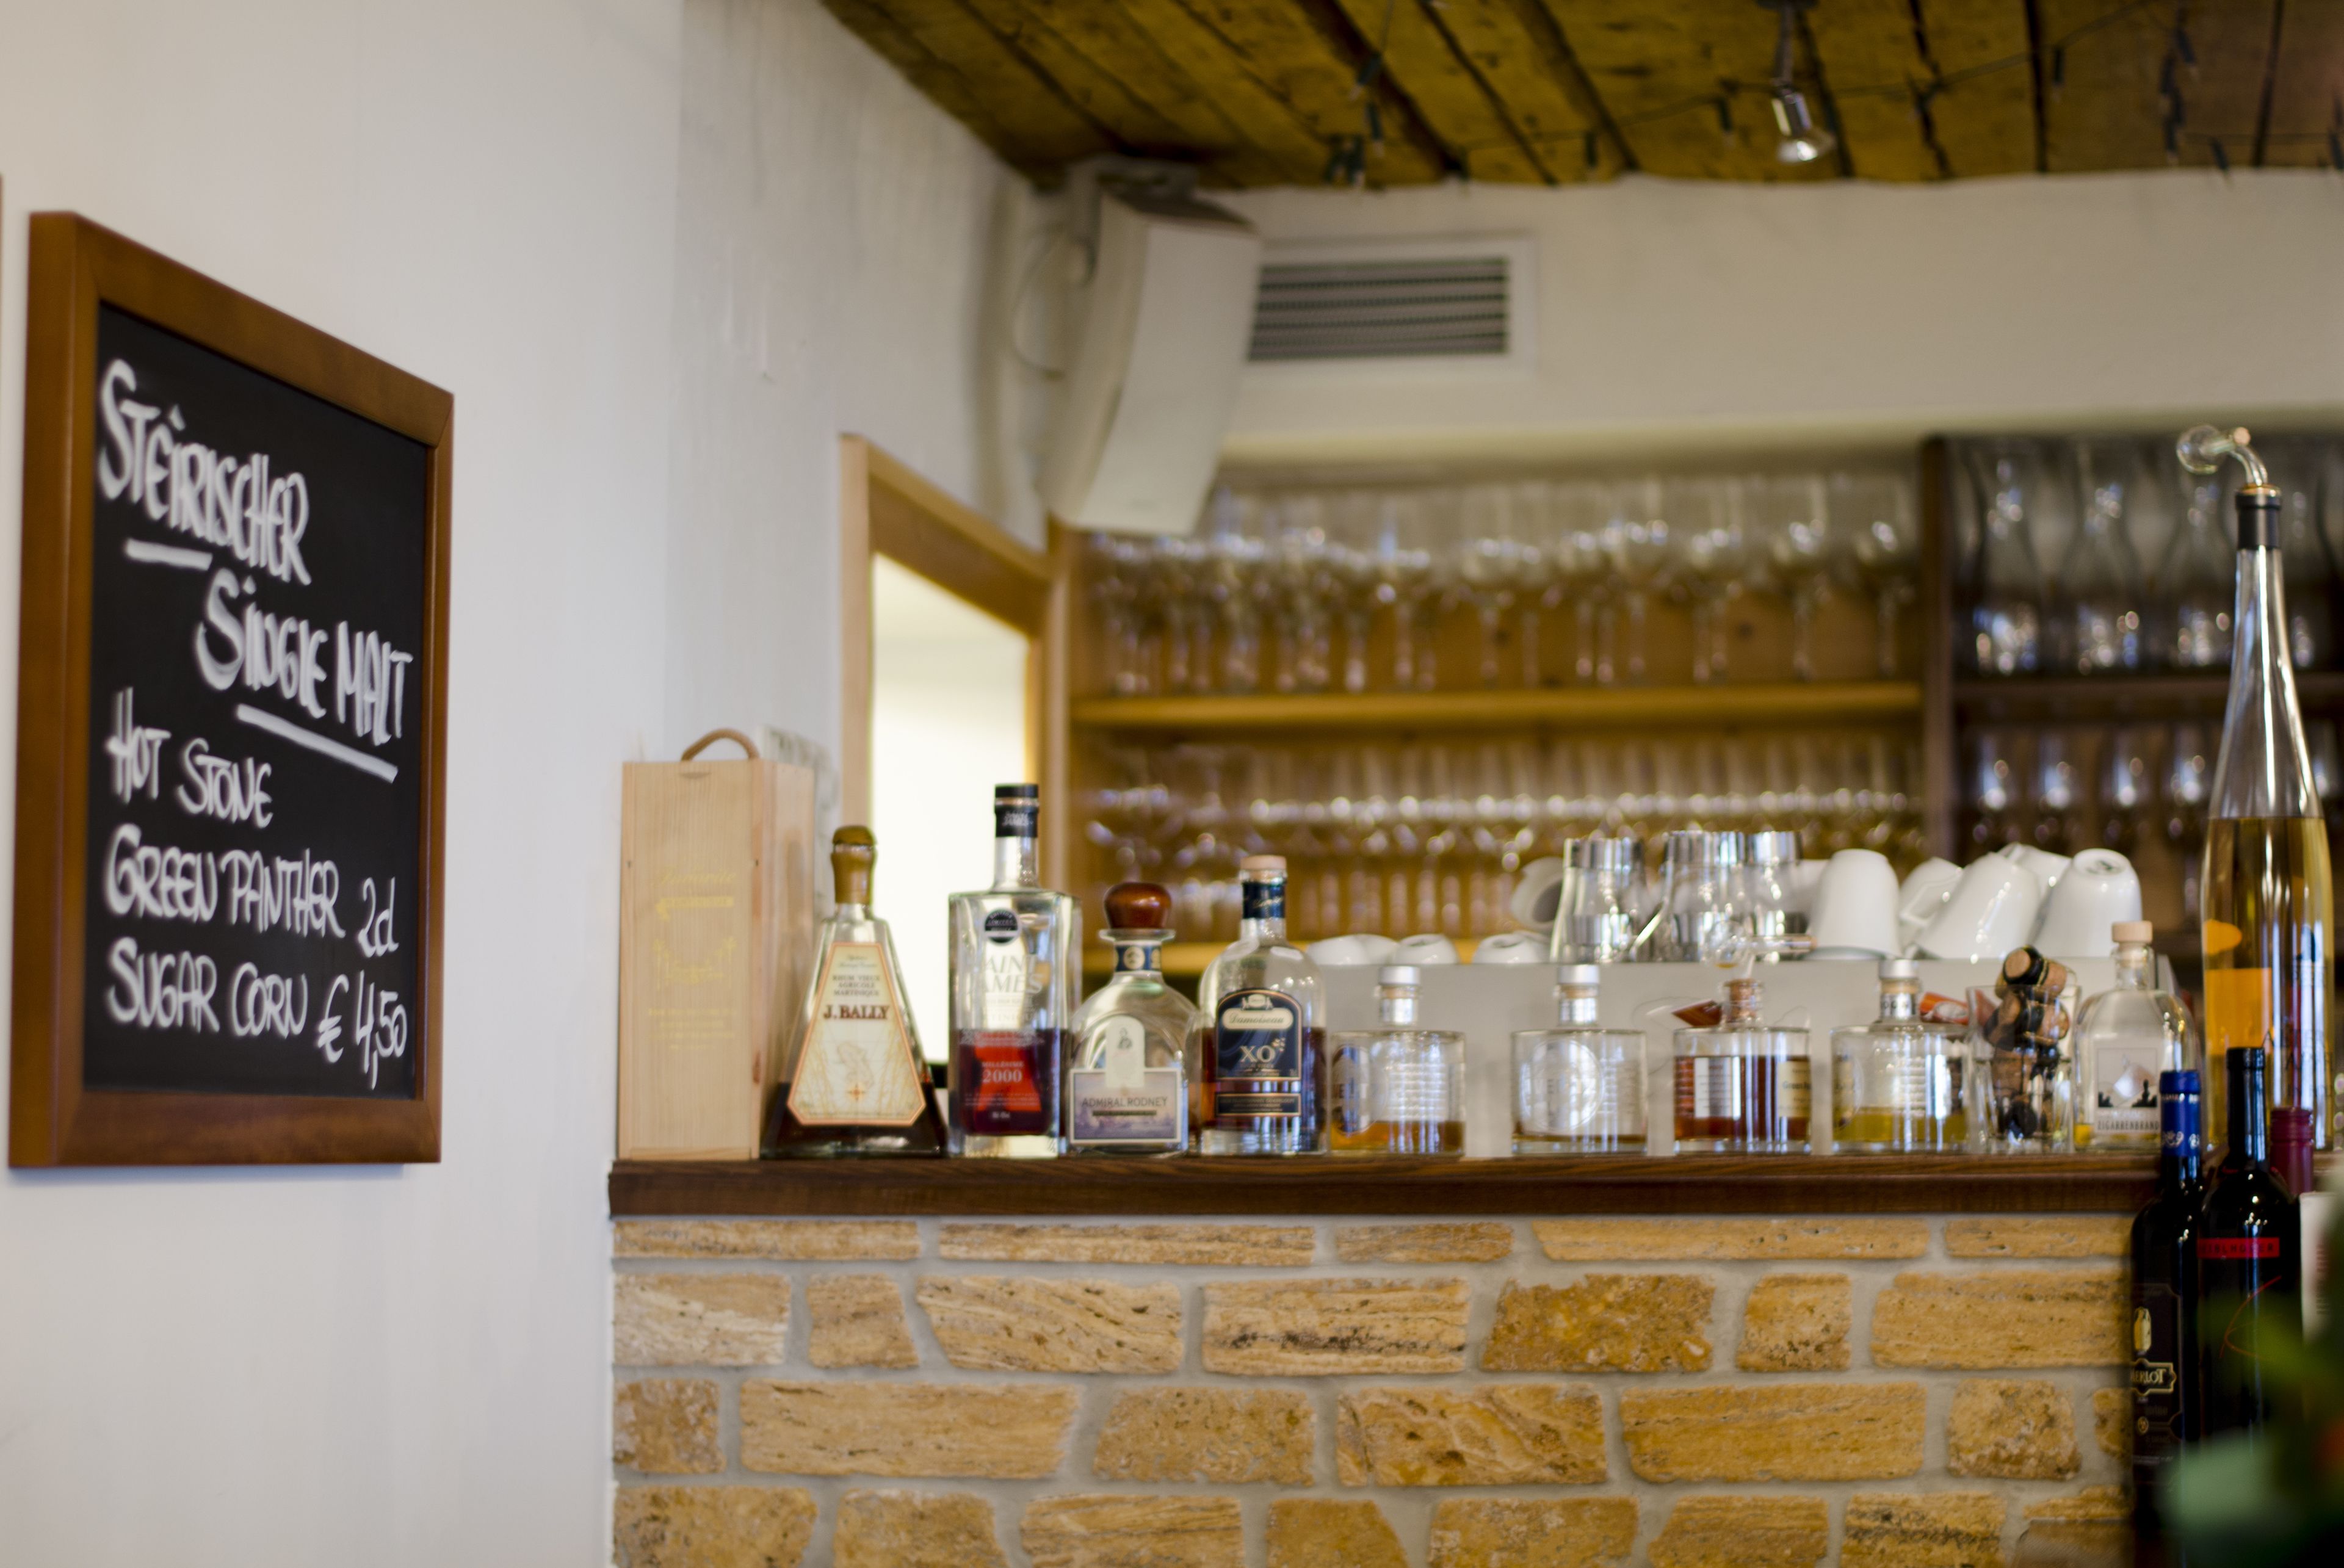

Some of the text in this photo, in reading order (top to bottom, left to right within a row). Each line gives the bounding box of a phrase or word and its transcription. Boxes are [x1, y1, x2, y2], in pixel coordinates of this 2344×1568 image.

[335, 621, 414, 746] MALT
[104, 687, 273, 828] HOT STONE
[104, 824, 219, 922] GREEN
[220, 847, 346, 938] PANTHER
[106, 936, 408, 1091] SUGAR CORN € 4,50
[1240, 1045, 1276, 1063] XO
[982, 1069, 1023, 1084] 2000
[1082, 1096, 1168, 1108] ADMIRAL RODNEY
